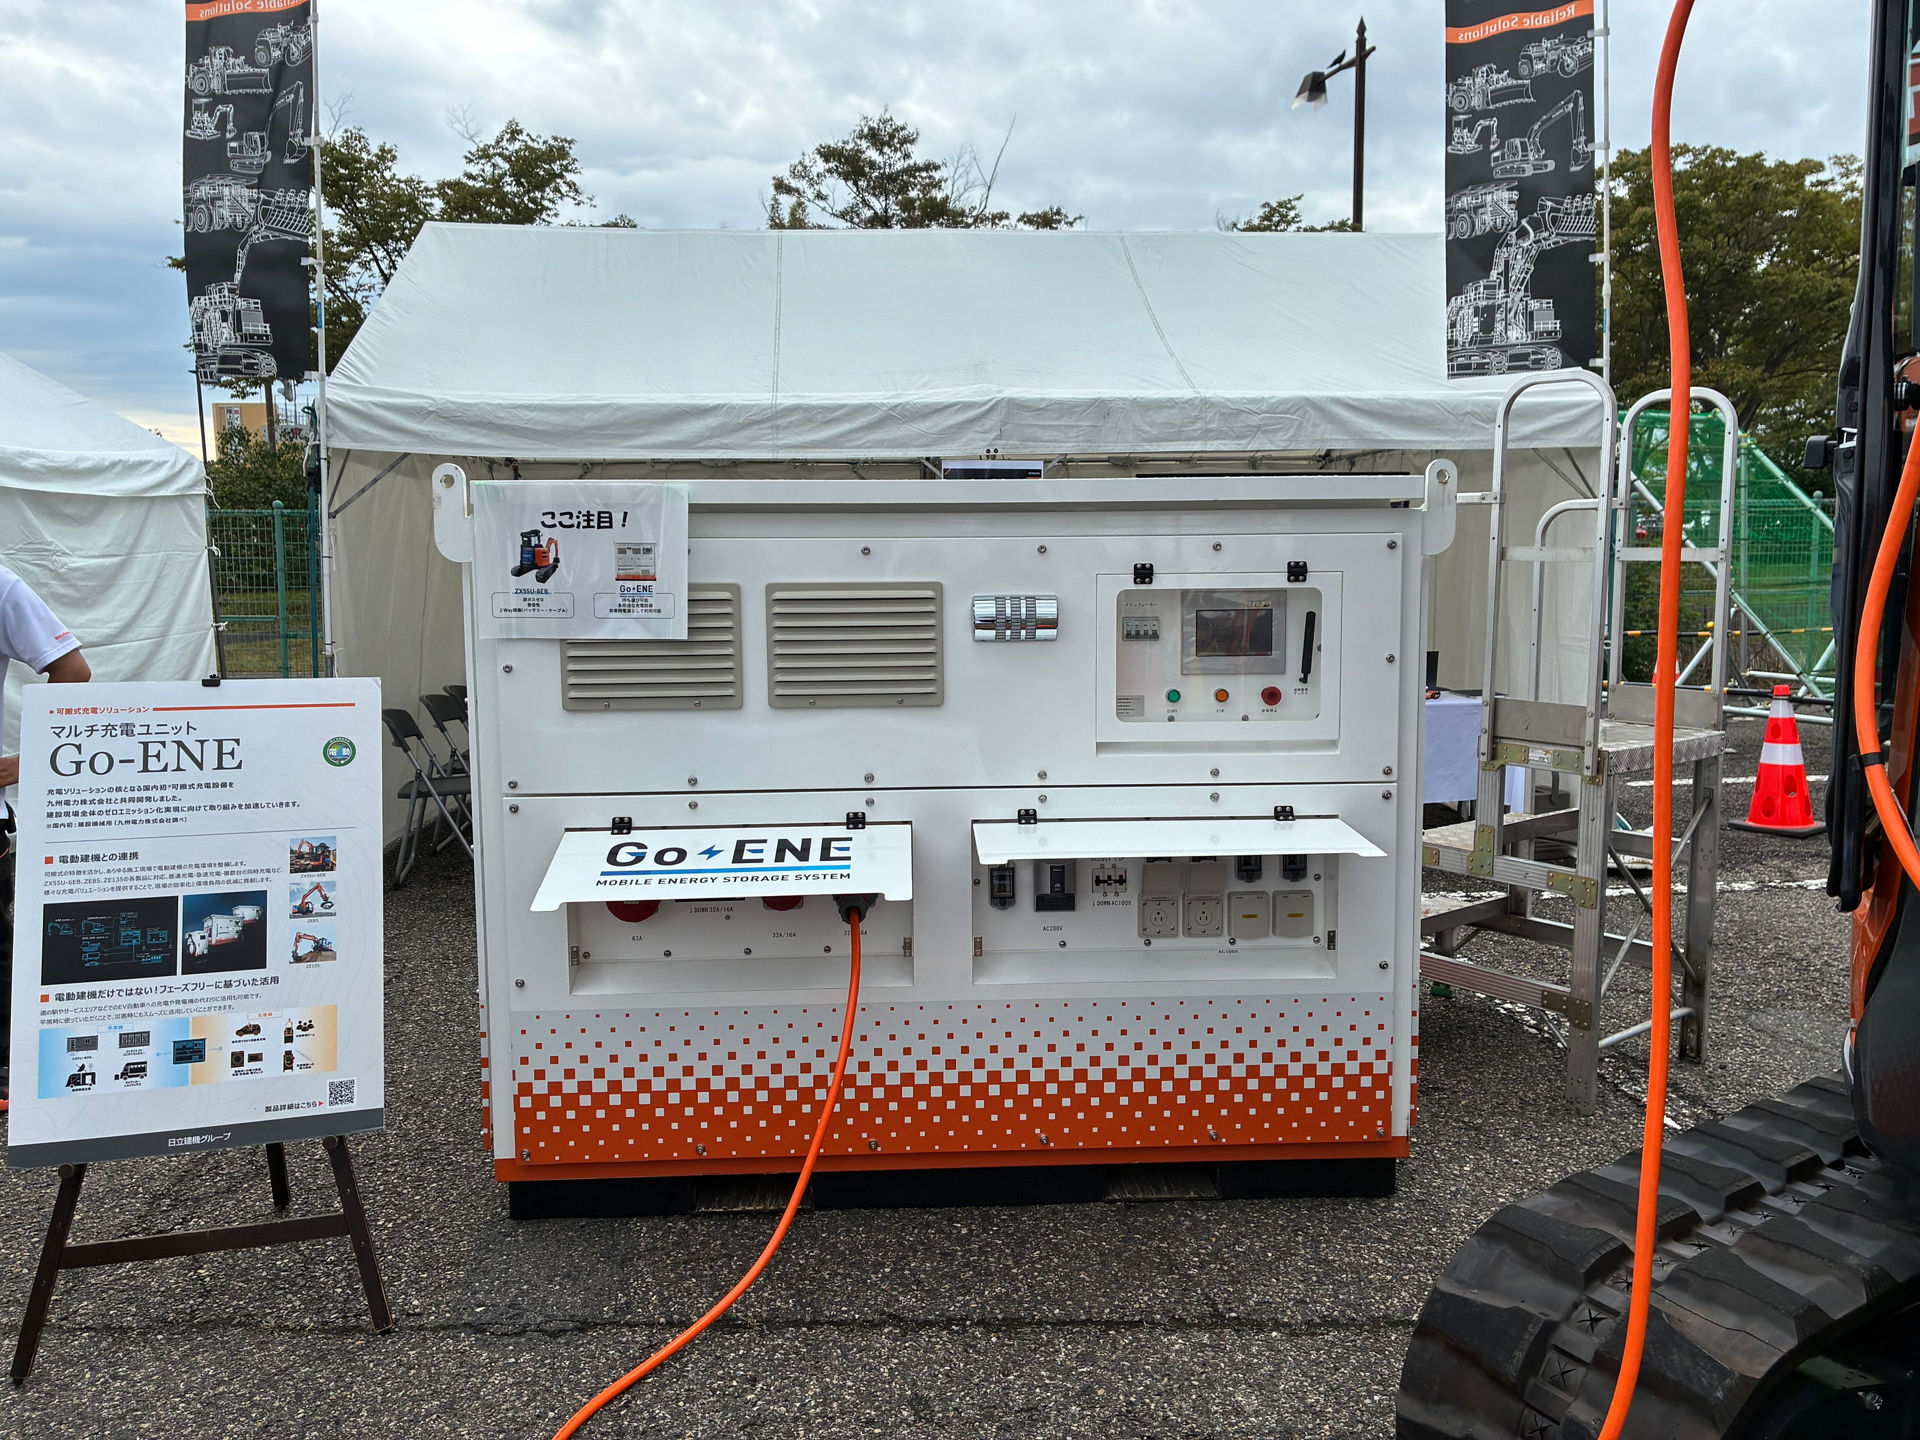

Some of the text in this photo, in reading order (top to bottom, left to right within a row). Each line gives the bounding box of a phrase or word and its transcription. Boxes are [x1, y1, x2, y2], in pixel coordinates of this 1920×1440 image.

[540, 510, 629, 530] ここ注目！
[637, 585, 653, 593] ENE
[56, 706, 150, 716] 可搬式充電ソリューション
[50, 721, 197, 739] マルチ充電ユニット
[50, 738, 244, 777] Go-ENE
[46, 795, 182, 807] 九州電力株式会社と共同開発しました。
[46, 801, 300, 819] 建設現場全体のゼロエミッション化実現に向けて取り組みを加速していきます。
[59, 851, 139, 864] 電動建機との連携
[606, 836, 854, 867] Go ENE
[596, 872, 851, 886] MOBILE ENERGY STORAGE SYSTEM
[54, 976, 279, 1002] 電動建機だけではない！フェーズフリーに基づいた活用
[264, 1101, 317, 1112] 製品詳細はこちら
[168, 1132, 232, 1147] 日立建機グループ
